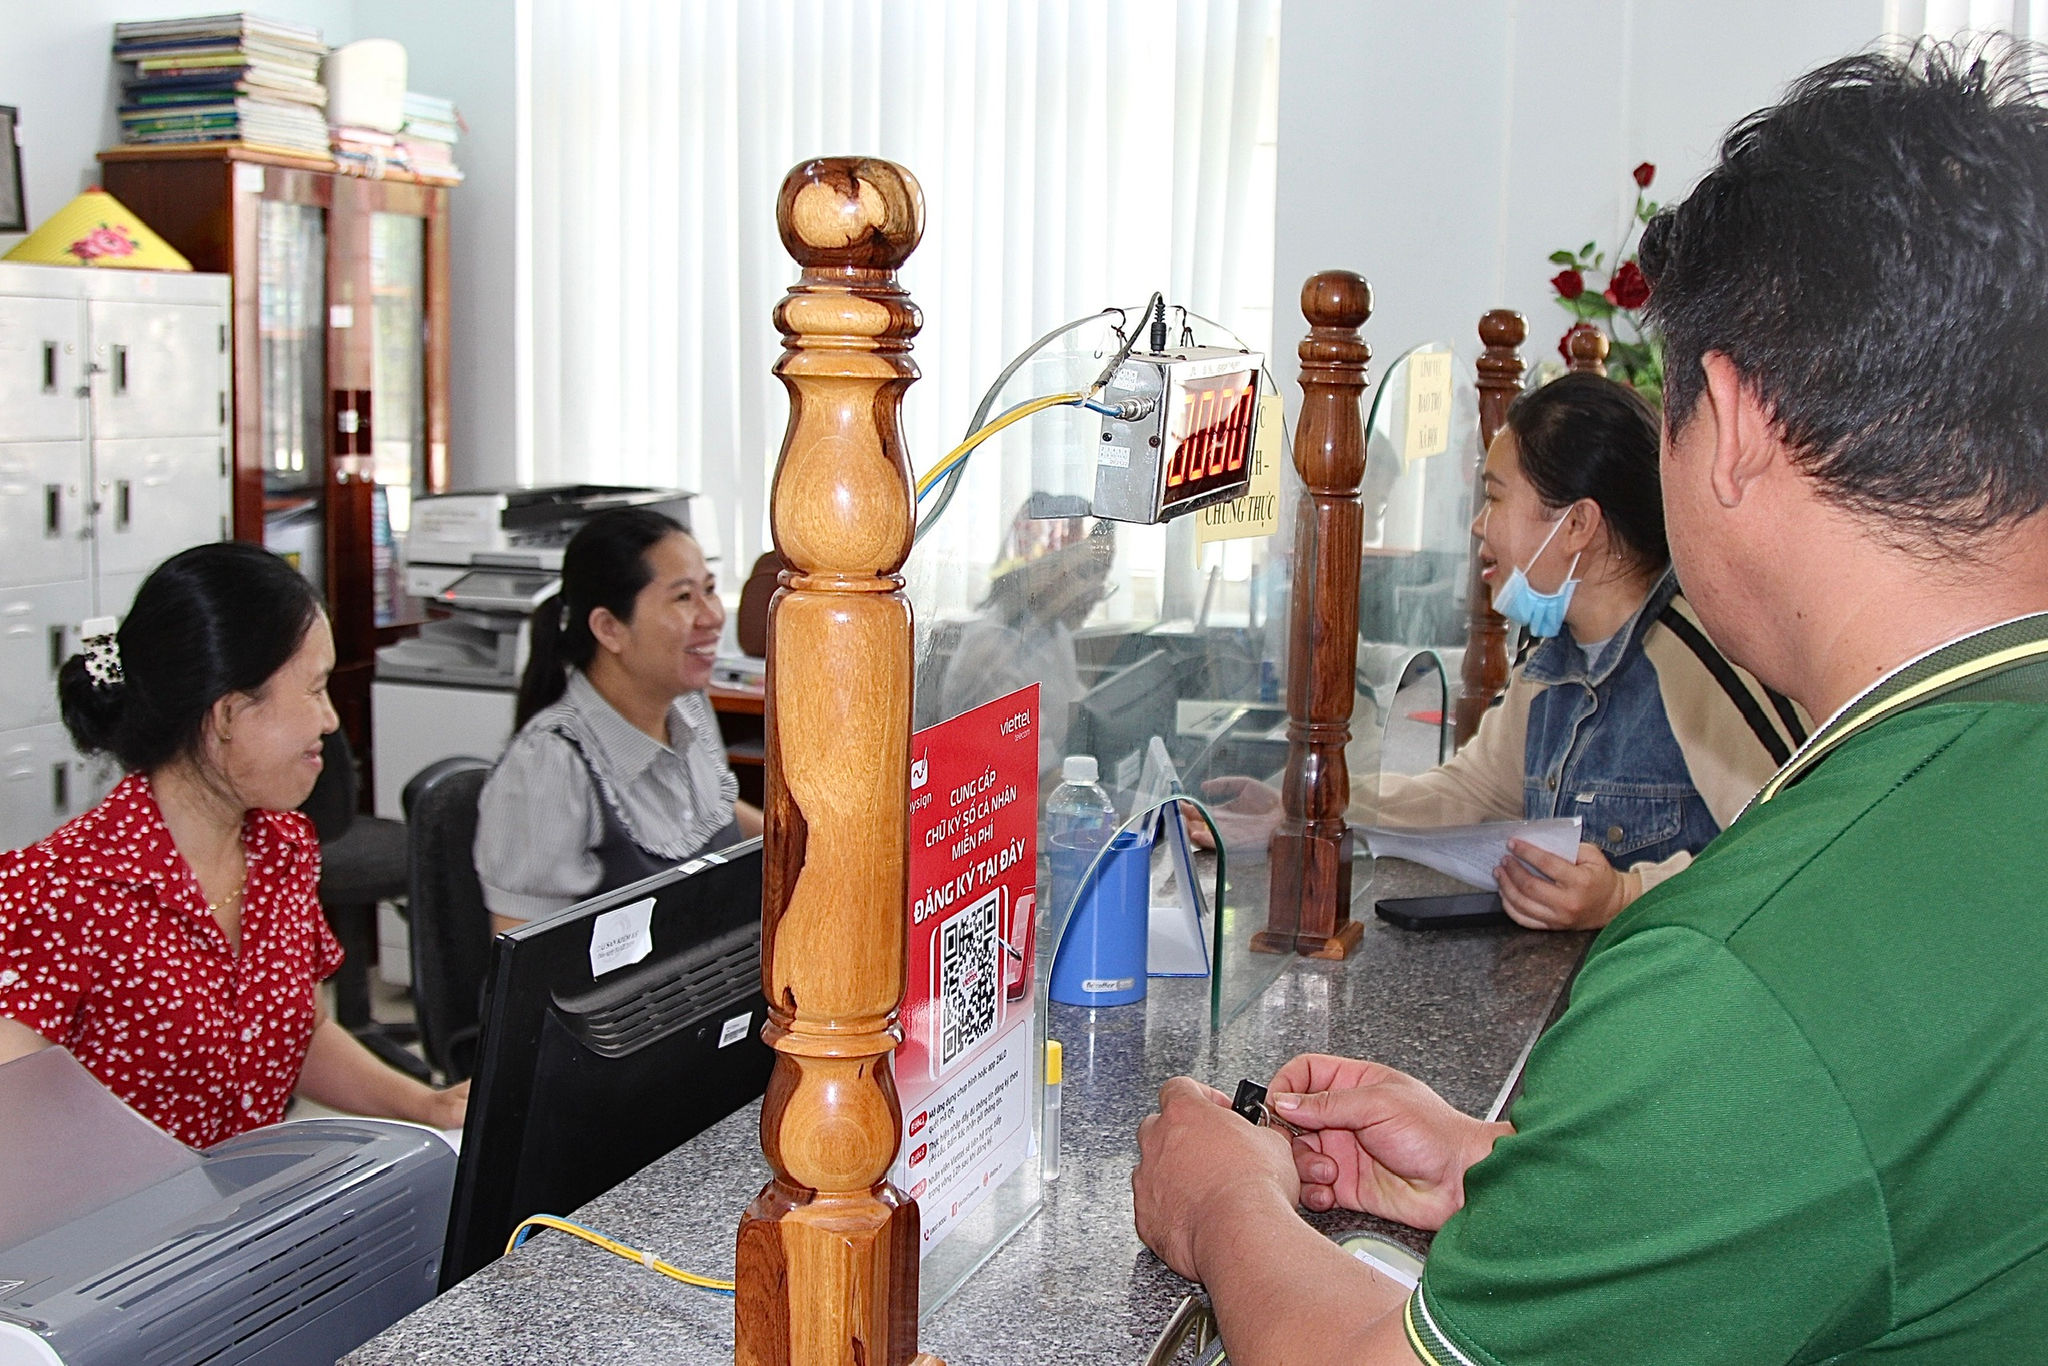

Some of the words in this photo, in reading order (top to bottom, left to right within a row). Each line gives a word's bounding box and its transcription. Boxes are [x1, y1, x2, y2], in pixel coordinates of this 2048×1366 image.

[1248, 491, 1276, 528] THỰC
[1000, 708, 1031, 737] viettel
[950, 780, 977, 808] CUNG
[978, 765, 997, 796] CẤP
[925, 818, 947, 848] CHỮ
[947, 809, 962, 837] KÝ
[963, 799, 977, 828] SỐ
[977, 794, 990, 820] CÁ
[991, 784, 1017, 812] NHÂN
[951, 828, 977, 861] MIỄN
[978, 820, 994, 849] PHÍ
[913, 886, 955, 925] ĐĂNG
[956, 861, 976, 900] KÝ
[976, 852, 998, 886] TẠI
[999, 838, 1026, 869] ĐÂY
